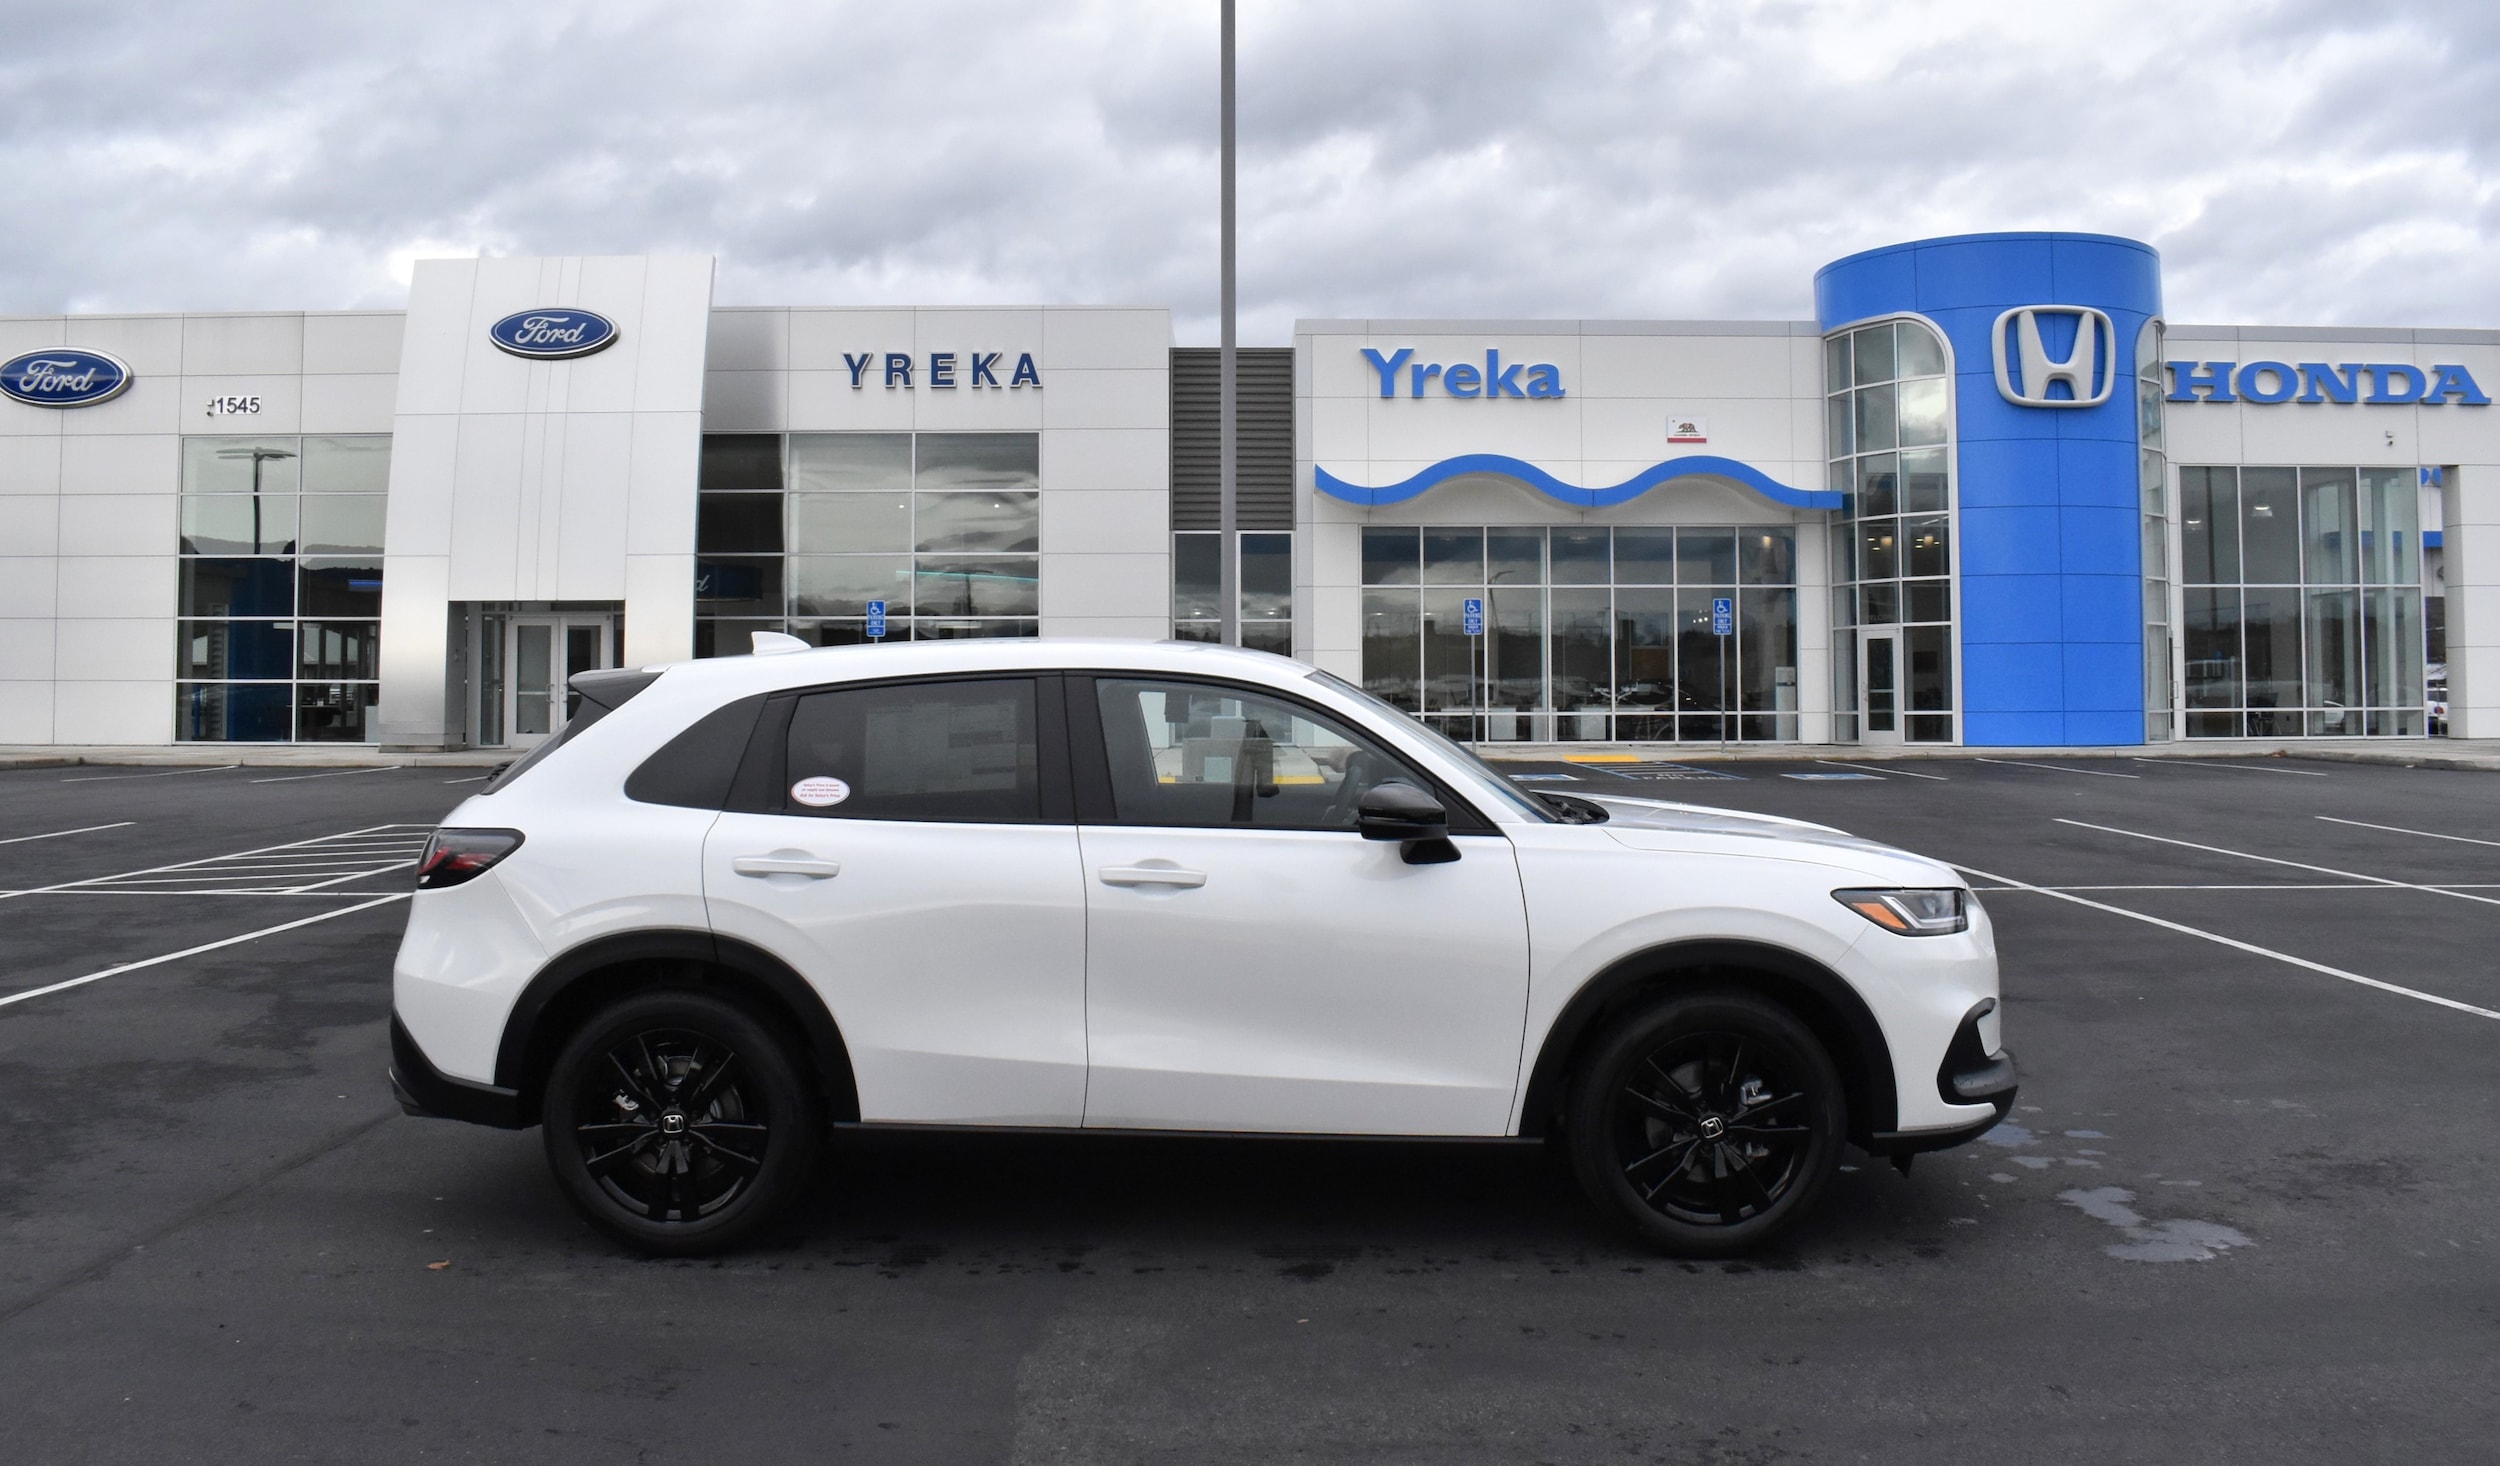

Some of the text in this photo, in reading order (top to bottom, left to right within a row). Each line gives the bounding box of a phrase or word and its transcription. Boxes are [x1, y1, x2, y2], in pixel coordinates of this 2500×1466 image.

[514, 316, 587, 344] Ford
[18, 359, 97, 392] Ford
[841, 352, 1044, 389] YREKA
[1359, 348, 1567, 399] Yreka
[2165, 360, 2493, 405] HONDA
[216, 396, 260, 414] 1545
